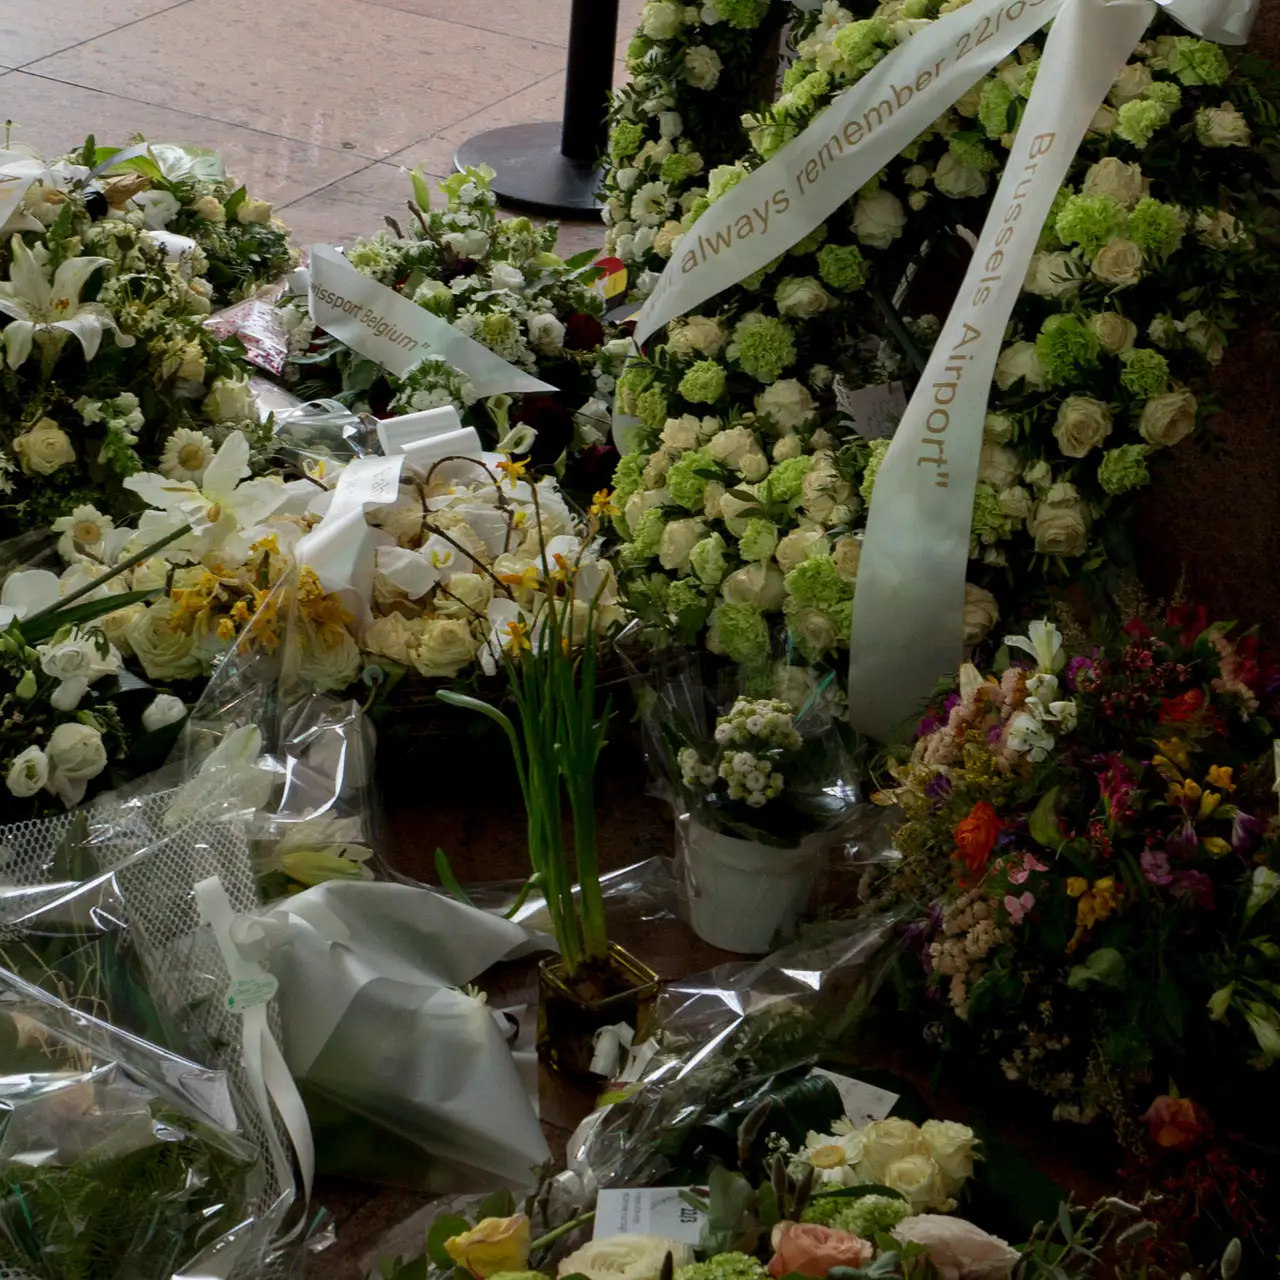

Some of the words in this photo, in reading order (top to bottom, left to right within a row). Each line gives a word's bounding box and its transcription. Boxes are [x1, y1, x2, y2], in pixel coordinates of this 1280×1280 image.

[680, 189, 791, 275] always
[795, 57, 948, 197] remember
[972, 131, 1057, 308] Brussels
[360, 308, 419, 352] Belgium
